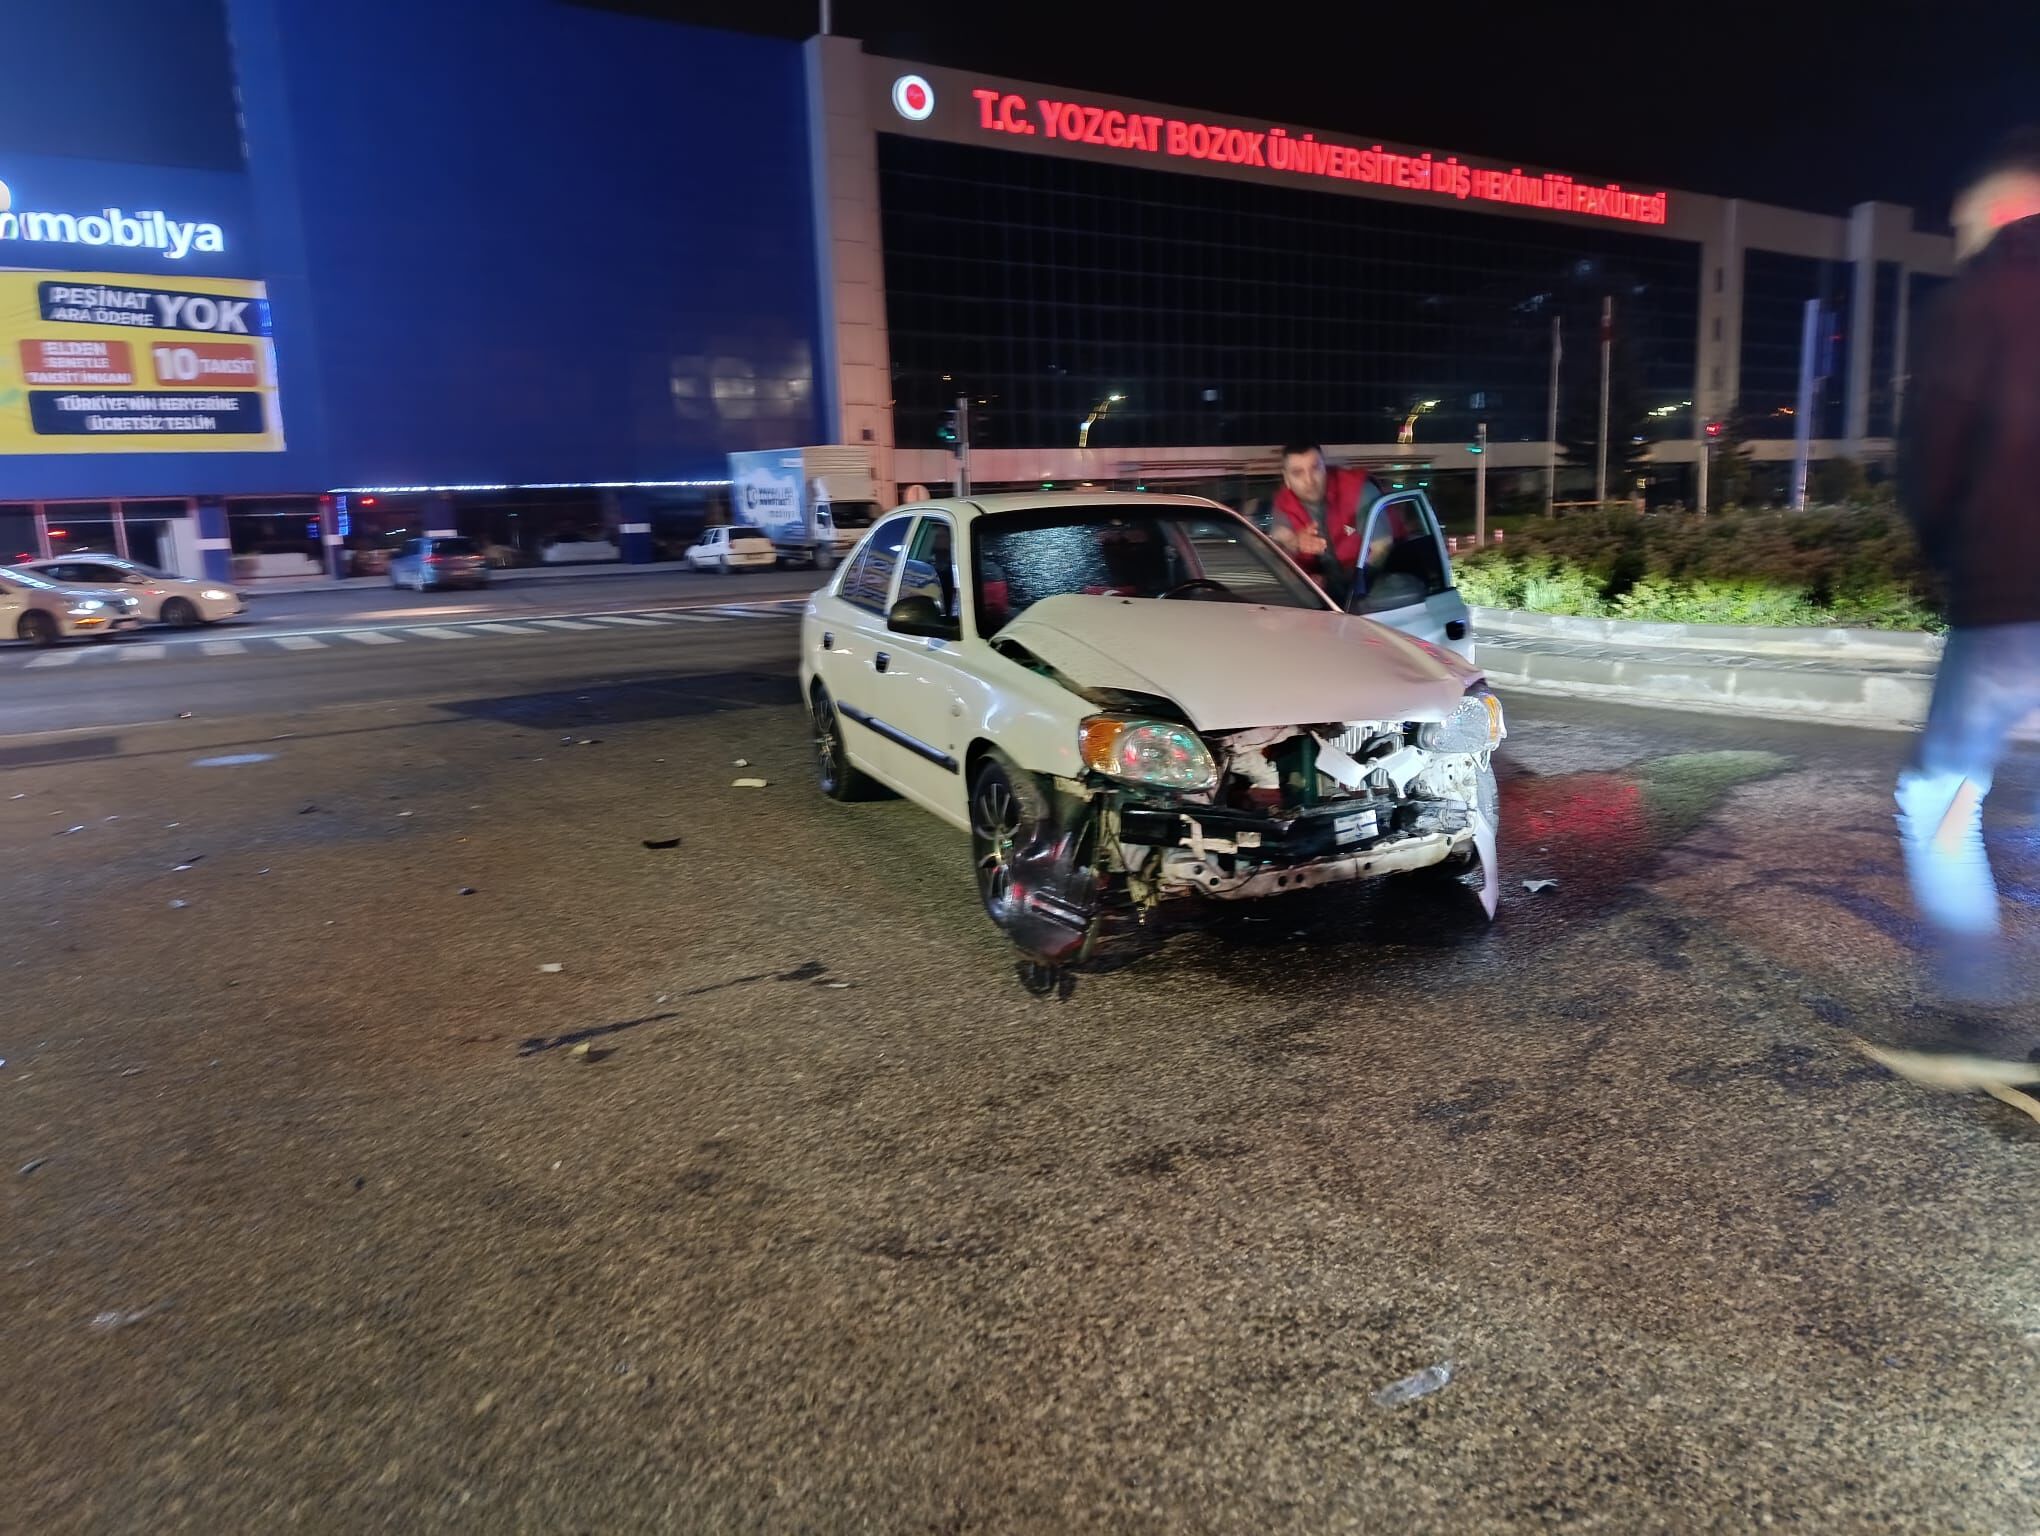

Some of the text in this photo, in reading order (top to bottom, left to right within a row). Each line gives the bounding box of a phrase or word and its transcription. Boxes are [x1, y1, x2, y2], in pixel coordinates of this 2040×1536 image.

[972, 89, 1666, 224] T.C. YOZGAT BOZOK ÜNİVERSİTESİ DİŞ HEKİMLİĞİ FAKÜLTESİ
[22, 208, 225, 259] mobilya
[51, 286, 151, 310] PEŞİNAT
[52, 306, 154, 327] ARA ÖDEME
[155, 294, 250, 334] YOK
[154, 347, 199, 381] 10
